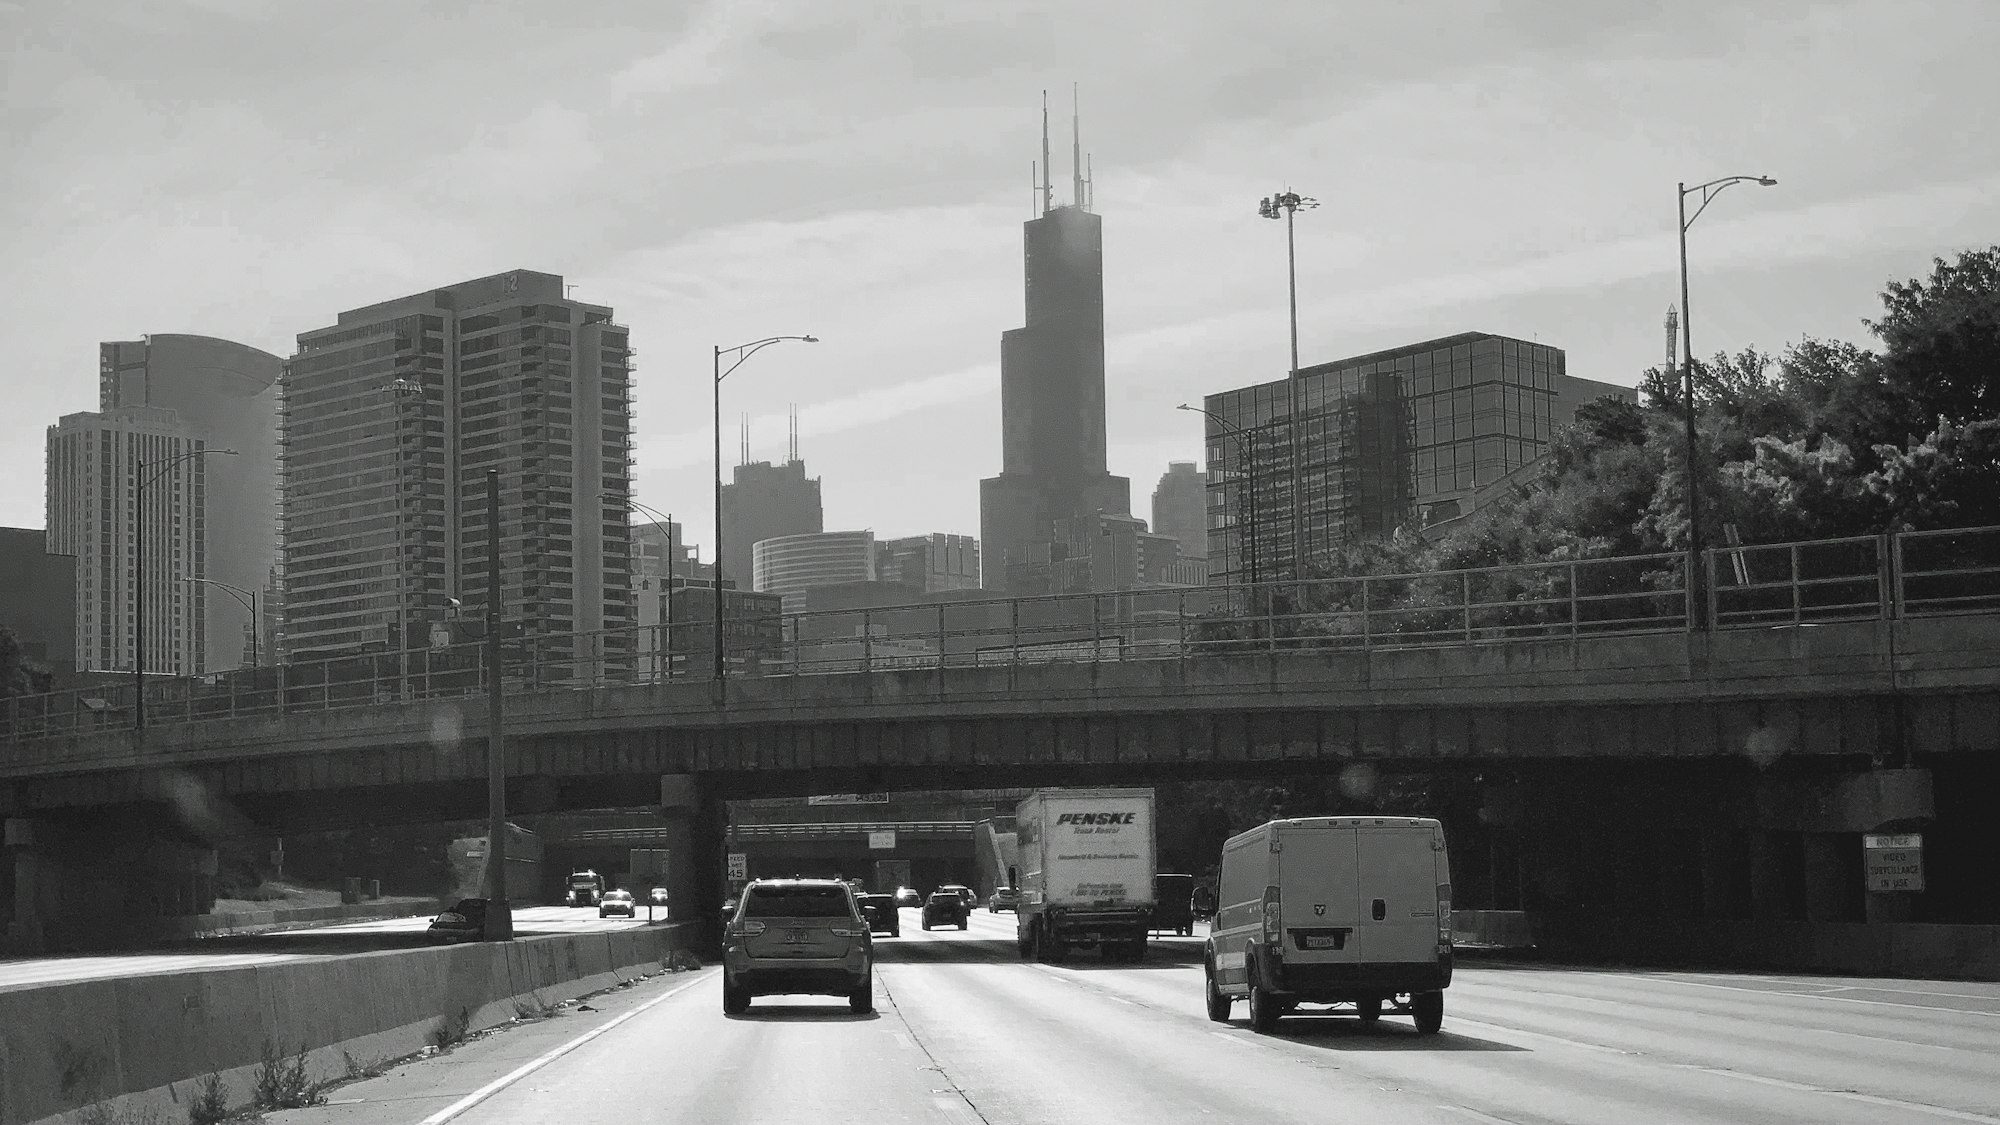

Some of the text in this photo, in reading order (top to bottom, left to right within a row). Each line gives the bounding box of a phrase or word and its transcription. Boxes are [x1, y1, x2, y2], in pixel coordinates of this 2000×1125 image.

[1056, 812, 1136, 825] PENSKE
[1876, 838, 1909, 847] NOTICE
[1883, 853, 1906, 861] VIDEO
[729, 869, 743, 877] 45
[1893, 878, 1909, 887] USE
